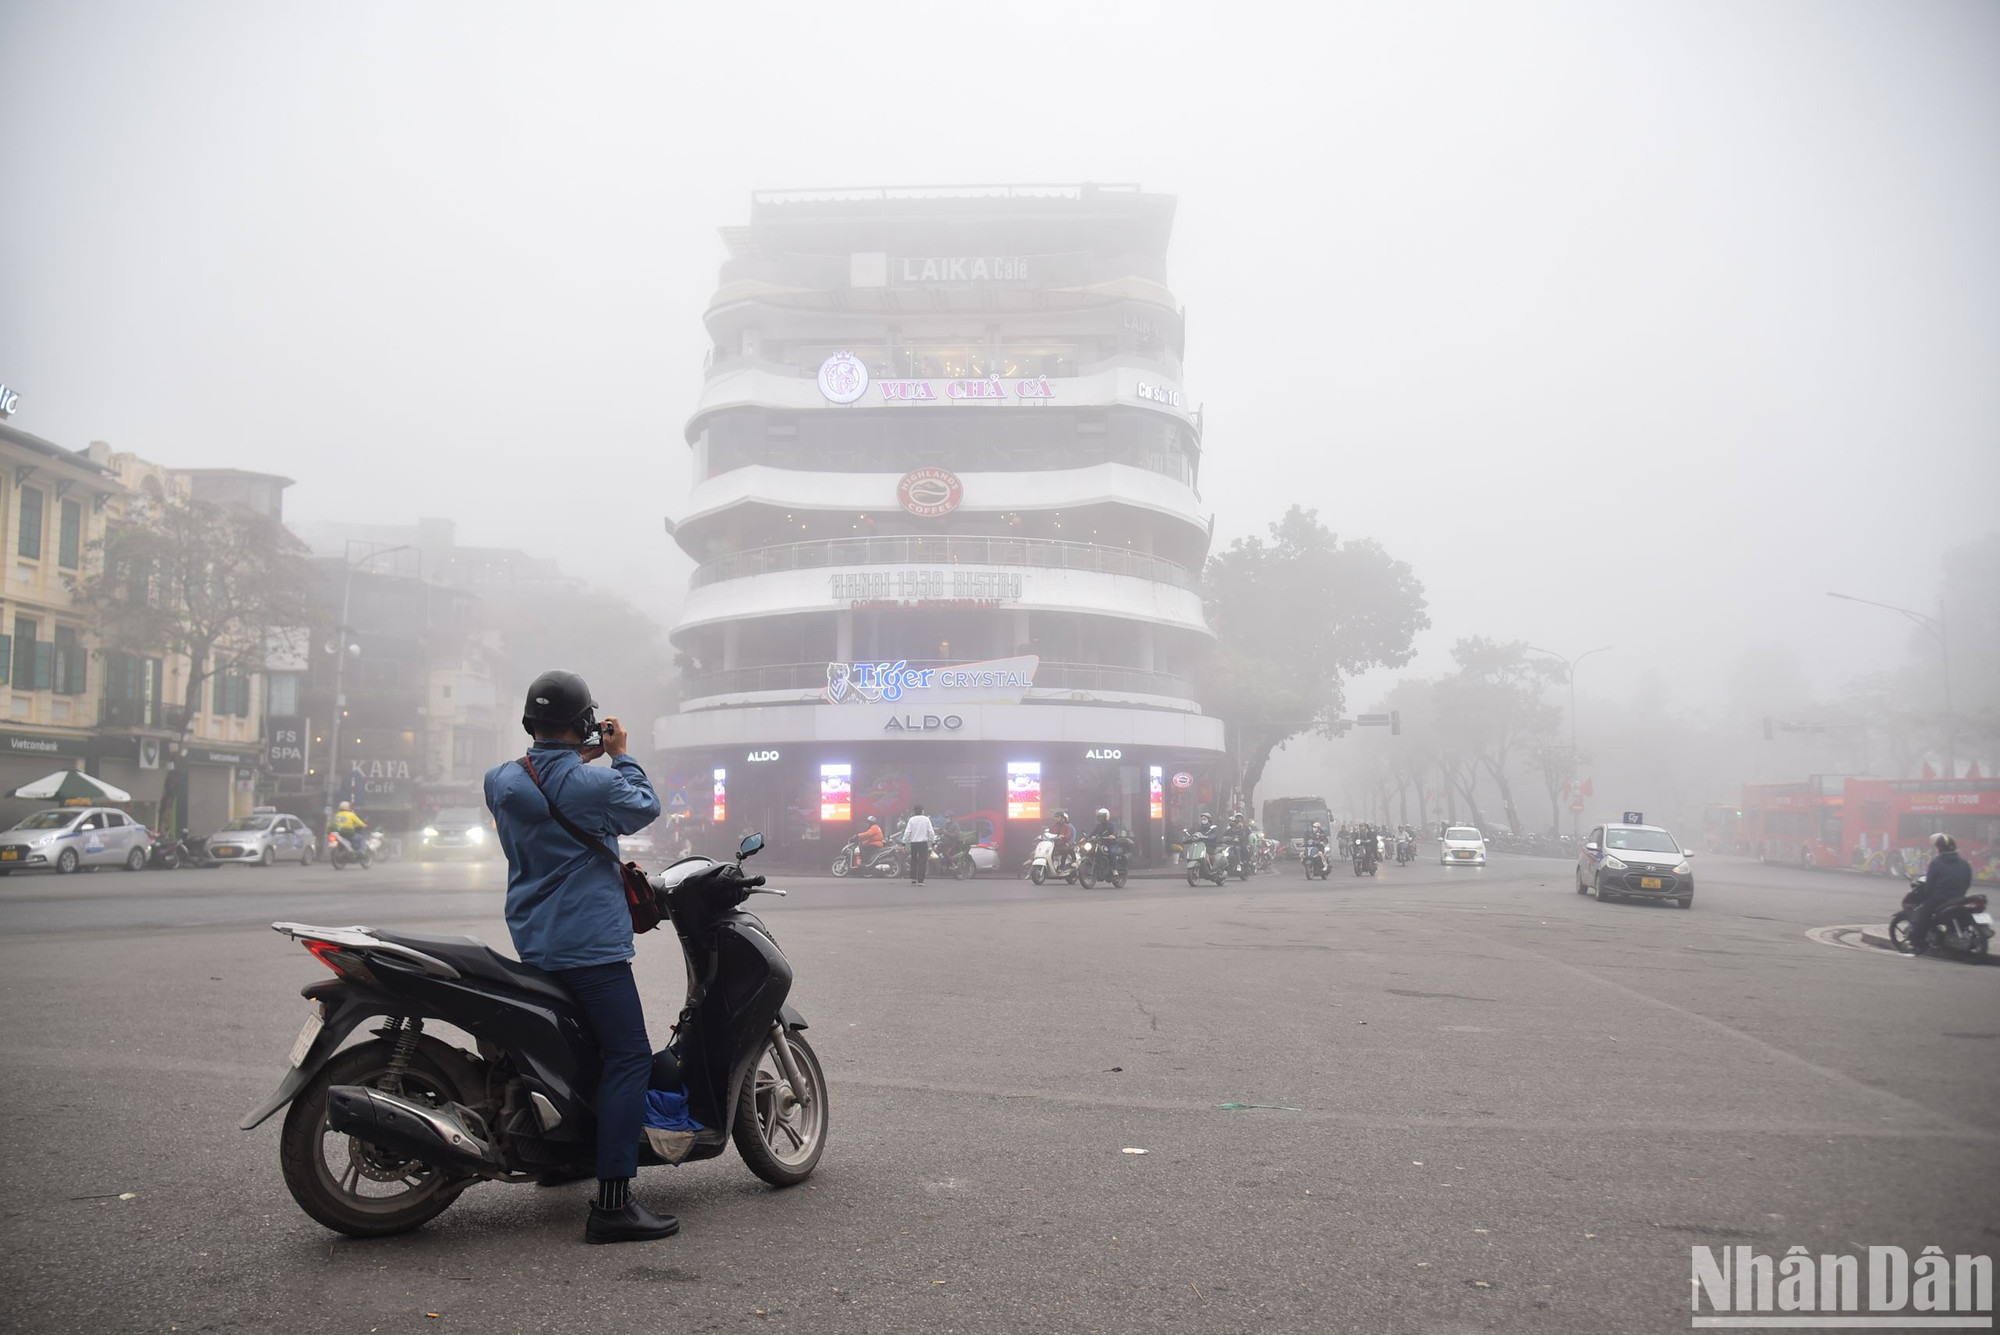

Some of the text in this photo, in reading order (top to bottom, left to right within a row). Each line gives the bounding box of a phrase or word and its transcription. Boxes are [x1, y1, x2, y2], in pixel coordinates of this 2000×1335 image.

[904, 257, 1028, 281] LAIKA Café
[878, 373, 1056, 400] VUA CHẢ CÁ
[1168, 390, 1180, 407] 10
[901, 469, 960, 491] HIGHLANDS
[907, 500, 954, 514] COFFEE
[831, 571, 1022, 599] HANOI 1930 BISTRO
[853, 660, 1033, 701] Tiger CRYSTAL
[883, 714, 964, 731] ALDO
[11, 737, 58, 752] Vietcombank
[276, 730, 297, 743] FS
[271, 747, 302, 760] SPA
[747, 750, 780, 762] ALDO
[1085, 749, 1122, 760] ALDO
[351, 759, 411, 779] KAFA
[364, 780, 396, 794] Café
[1937, 794, 1956, 804] CITY
[1958, 794, 1979, 805] TOUR
